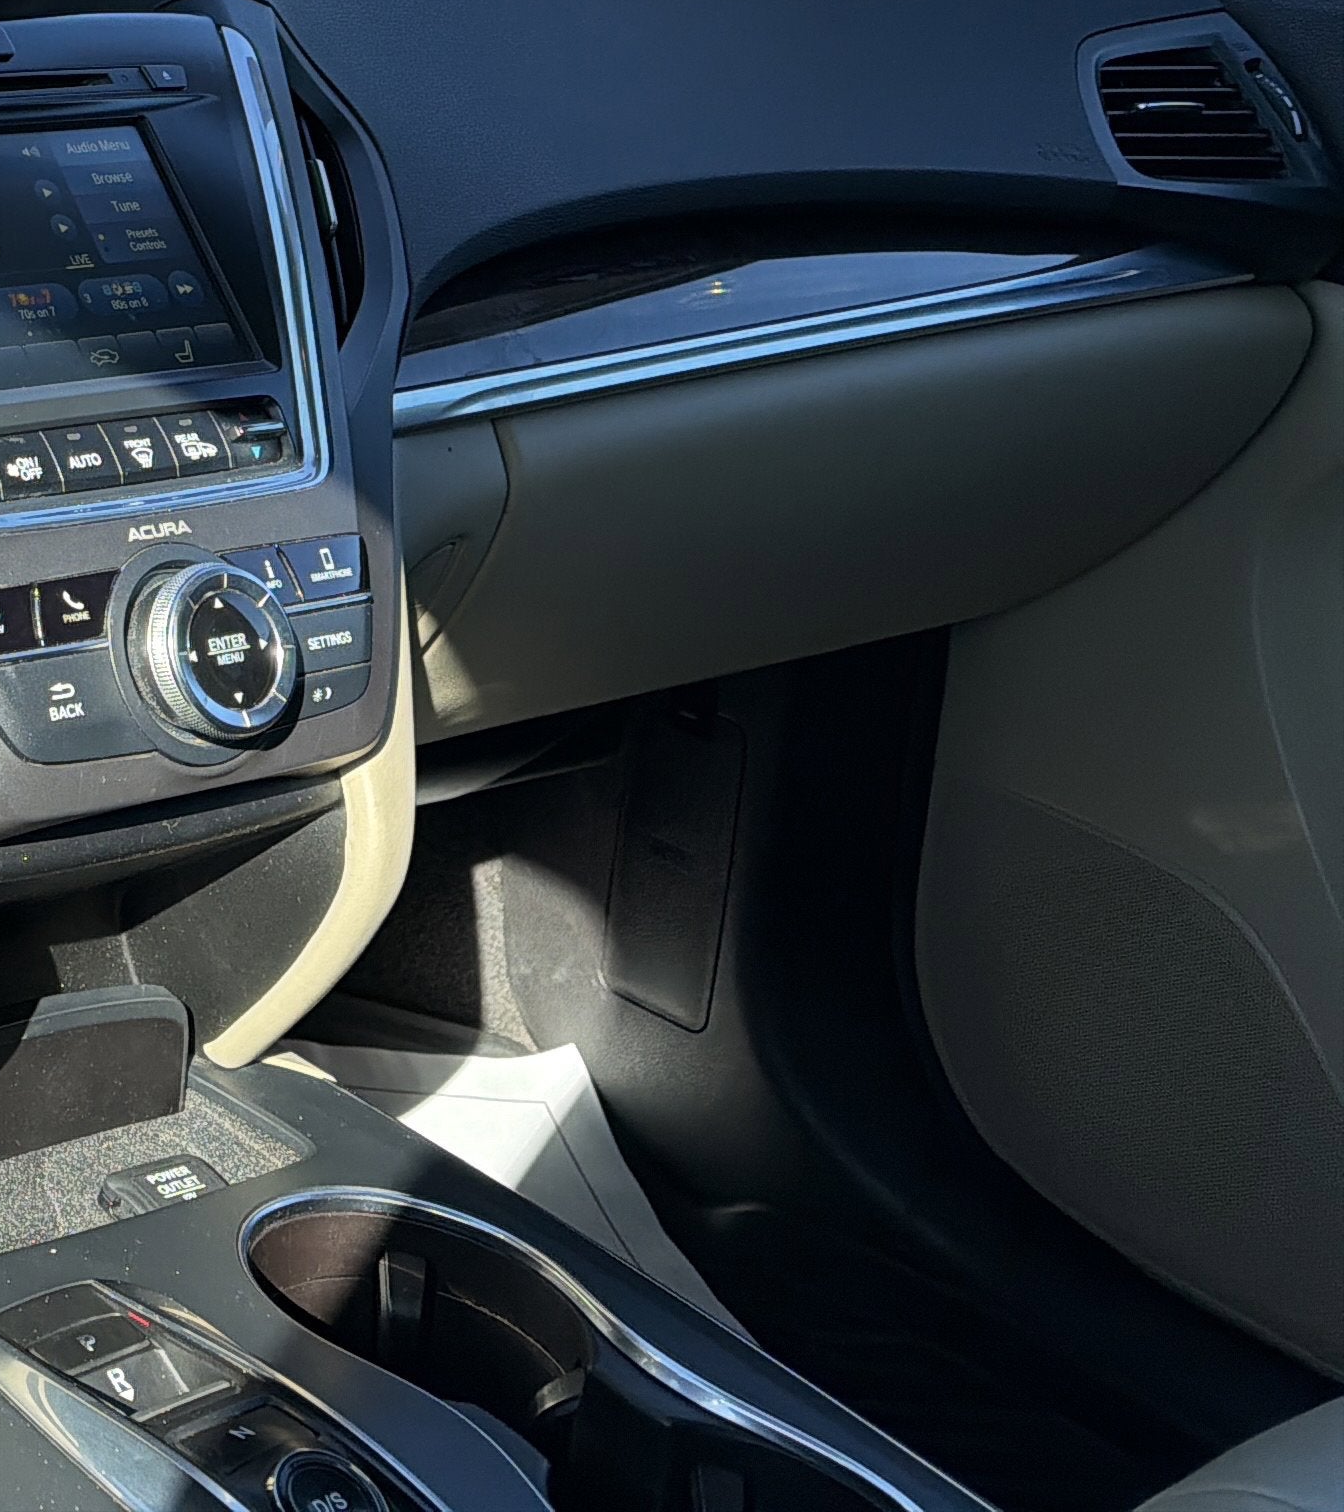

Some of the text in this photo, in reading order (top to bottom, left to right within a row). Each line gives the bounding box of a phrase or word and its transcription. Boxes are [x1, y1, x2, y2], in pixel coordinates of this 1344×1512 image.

[65, 140, 131, 154] Audio Menu
[90, 171, 134, 185] Browse
[110, 199, 142, 213] Tune
[125, 227, 159, 239] Presets
[129, 239, 167, 252] Controls
[69, 253, 92, 265] LIVE
[83, 293, 92, 304] 3
[129, 299, 141, 309] on
[17, 306, 56, 320] 70s on 7
[123, 437, 152, 449] FRONT
[174, 432, 199, 444] REAR
[68, 452, 102, 469] AUTO
[20, 466, 43, 481] OFF
[127, 519, 192, 543] ACURA
[62, 610, 92, 624] PHONE
[208, 632, 247, 651] ENTER
[307, 630, 353, 651] SETTINGS
[216, 651, 245, 667] MENU
[49, 702, 85, 722] BACK
[144, 1165, 192, 1185] POWER
[156, 1174, 201, 1195] OUTLET
[78, 1334, 96, 1352] P
[106, 1367, 127, 1393] R
[228, 1425, 257, 1440] N
[311, 1491, 349, 1512] D/S
